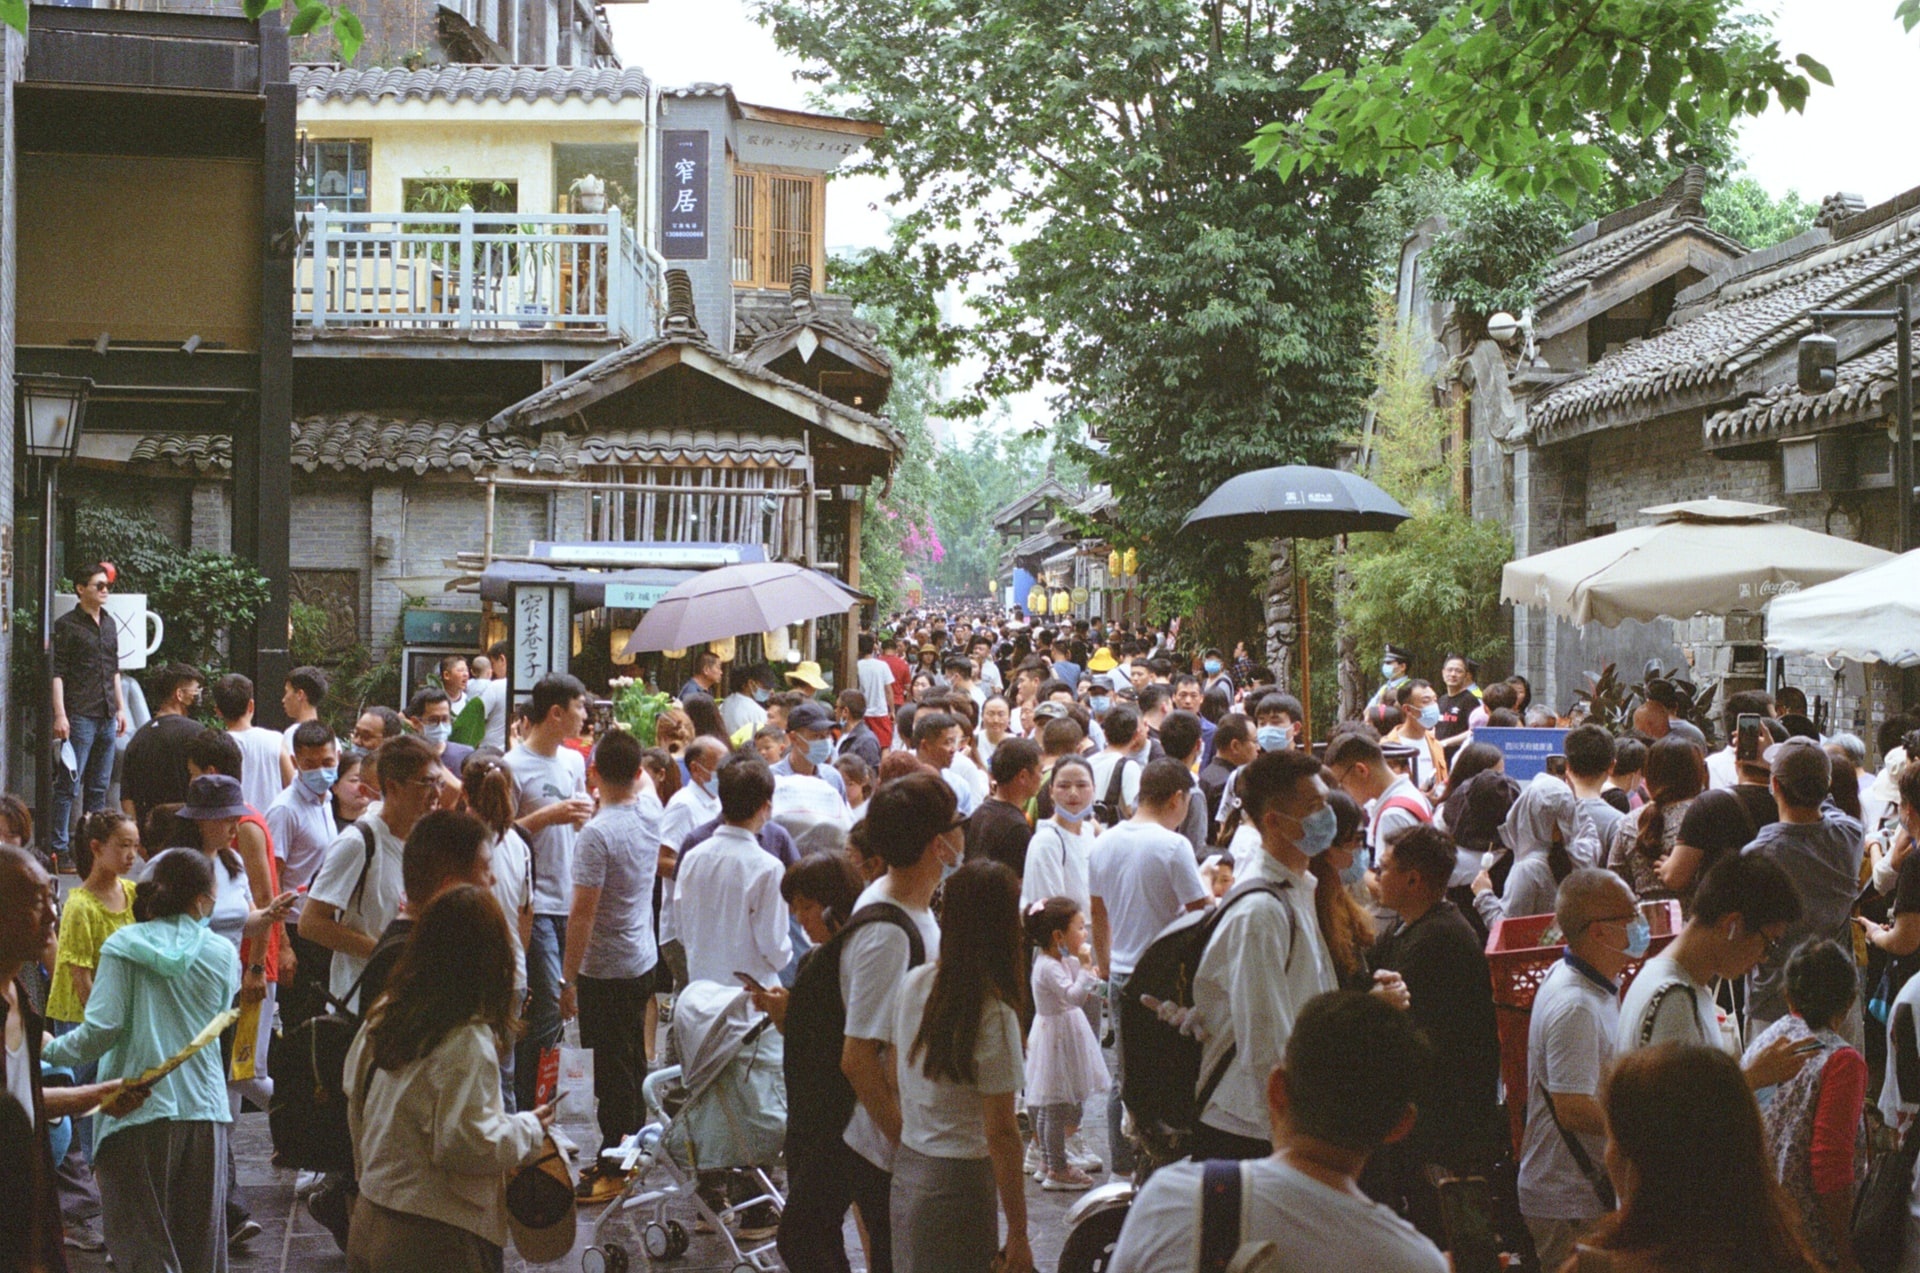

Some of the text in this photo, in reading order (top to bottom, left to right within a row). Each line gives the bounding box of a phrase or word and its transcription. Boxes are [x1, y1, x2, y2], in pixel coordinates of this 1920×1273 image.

[672, 158, 698, 213] 窄居
[520, 594, 544, 678] 窄巷子
